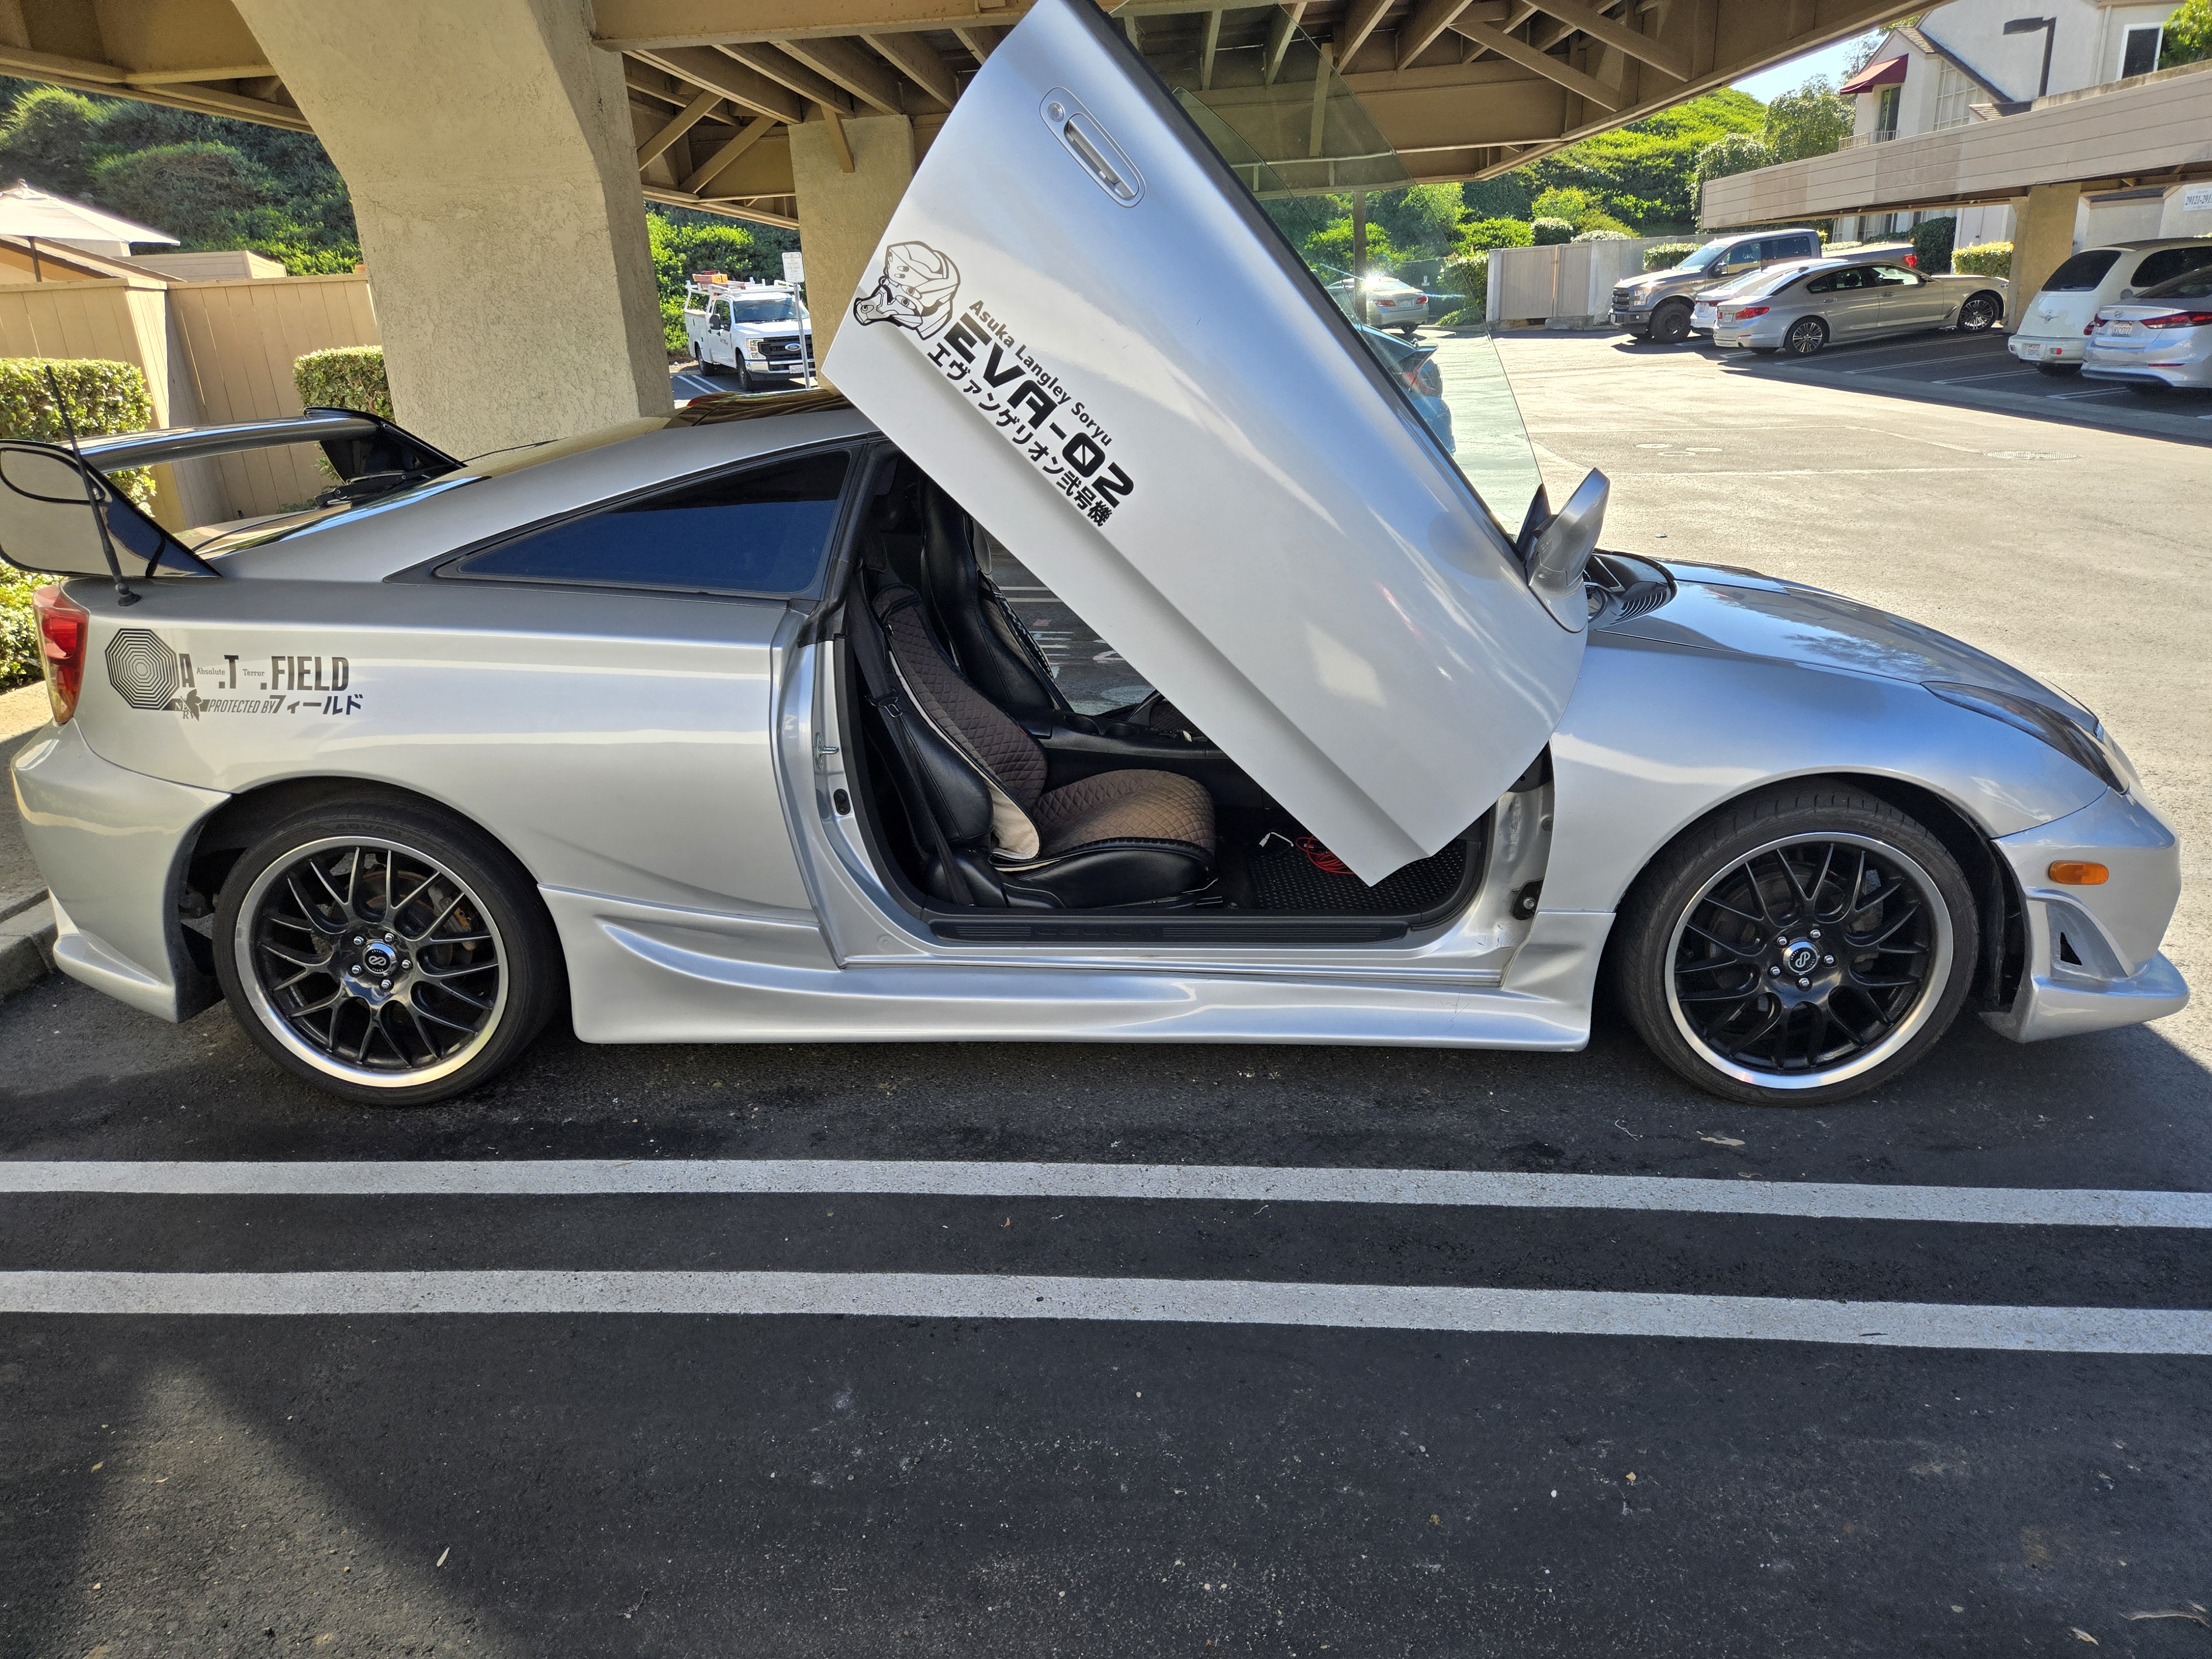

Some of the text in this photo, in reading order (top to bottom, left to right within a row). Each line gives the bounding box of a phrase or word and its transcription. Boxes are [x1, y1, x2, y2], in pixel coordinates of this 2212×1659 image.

[2185, 194, 2212, 205] 29121-291
[969, 300, 1112, 447] Asuka Langley Soryu
[943, 312, 1134, 509] EVA-02
[927, 342, 1114, 527] エヴァンゲリオン弐号機
[196, 667, 225, 676] Absolute
[242, 669, 265, 677] Terror
[207, 699, 276, 713] PROTECTED BY
[269, 694, 364, 715] フィールド
